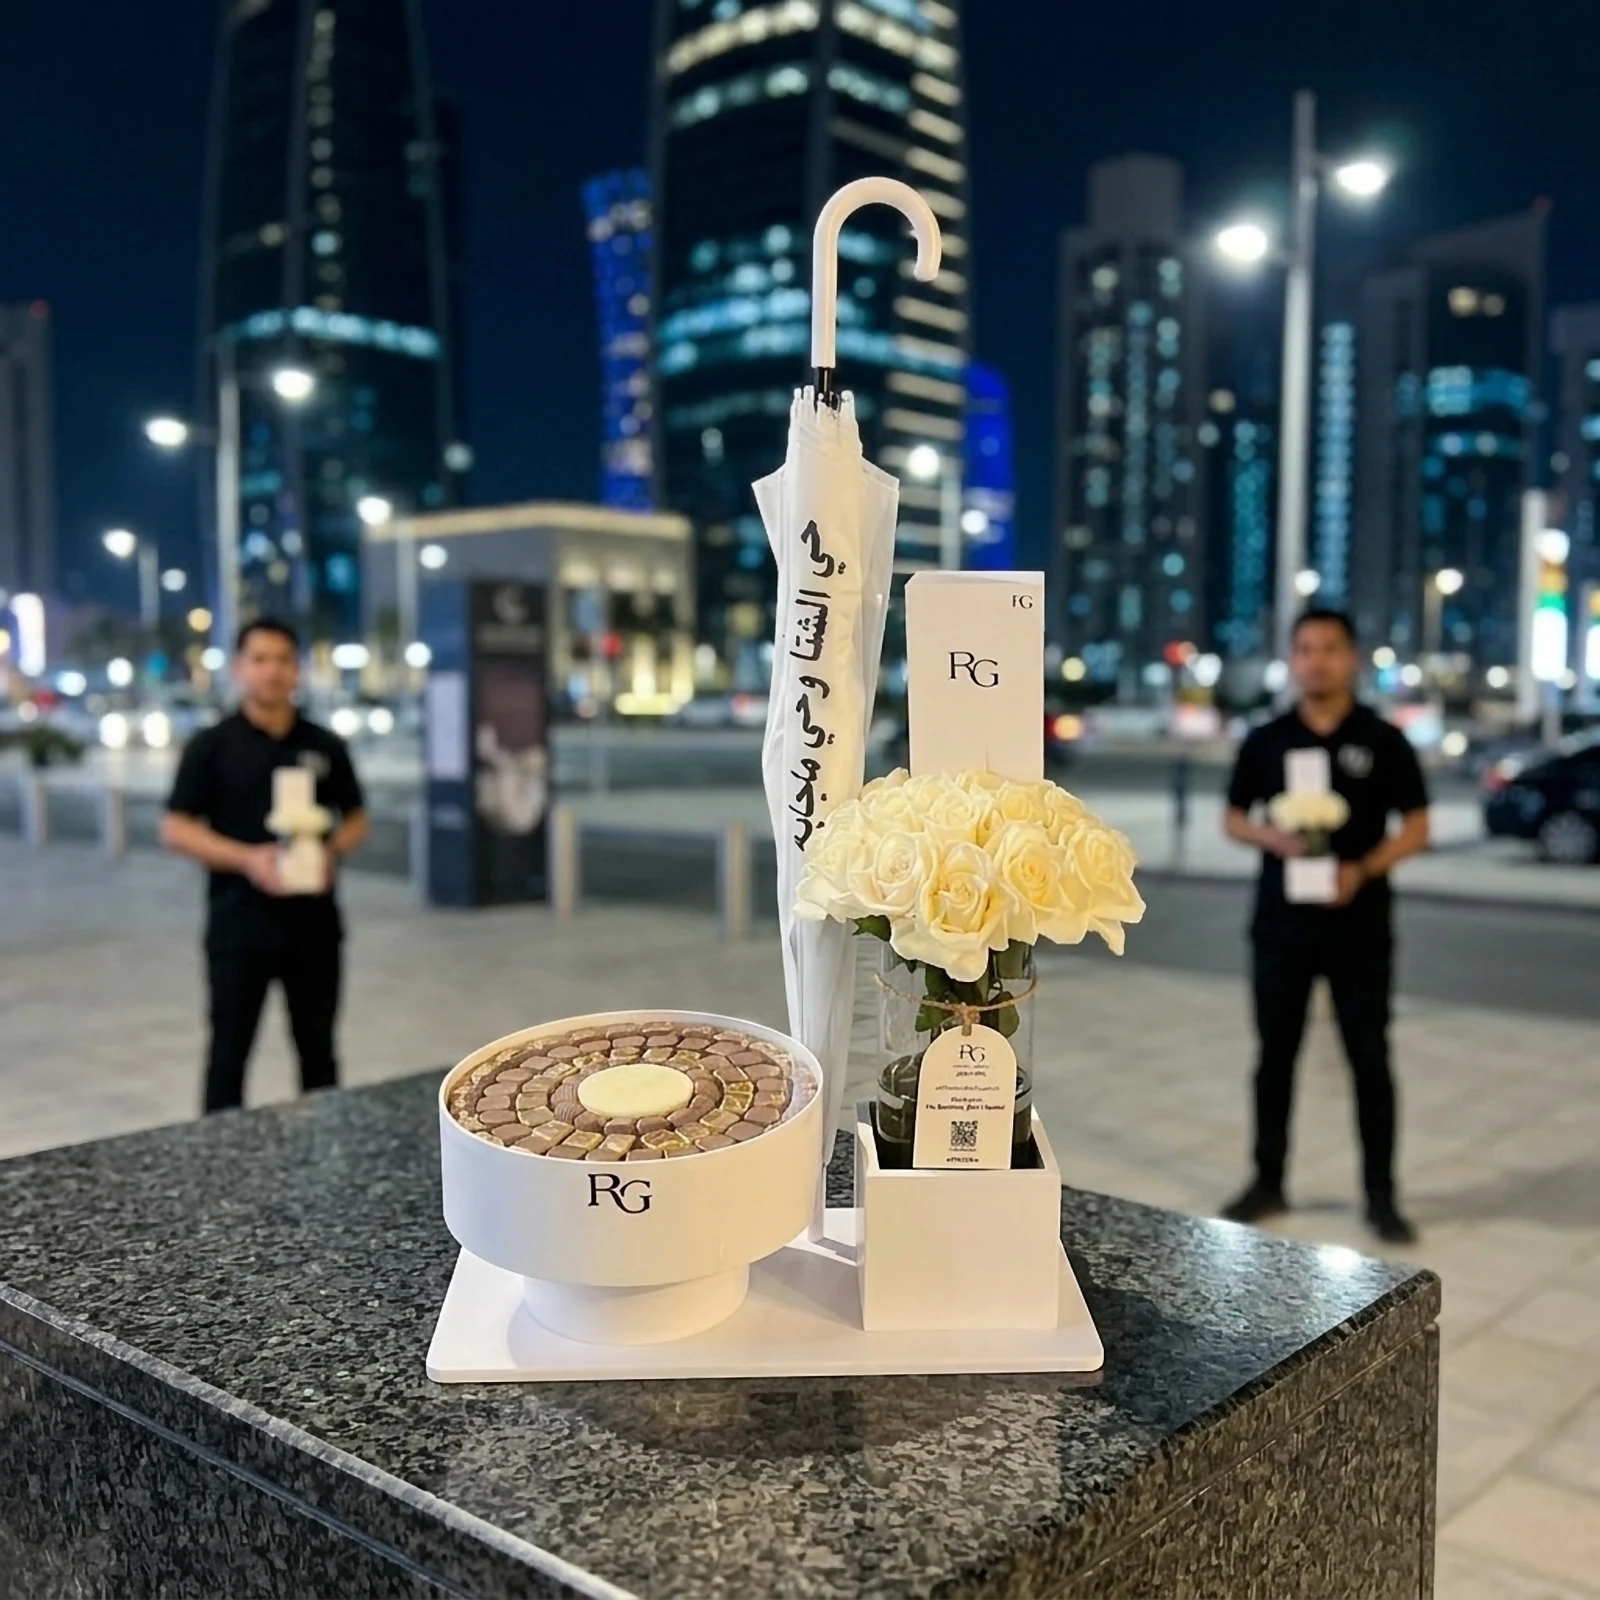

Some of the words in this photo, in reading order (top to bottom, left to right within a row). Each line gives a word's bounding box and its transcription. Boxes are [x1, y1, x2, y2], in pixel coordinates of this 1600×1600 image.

[800, 519, 847, 578] حي
[789, 589, 832, 662] الشتا
[948, 651, 999, 688] RG
[959, 1043, 986, 1063] RG
[587, 1173, 653, 1215] RG
